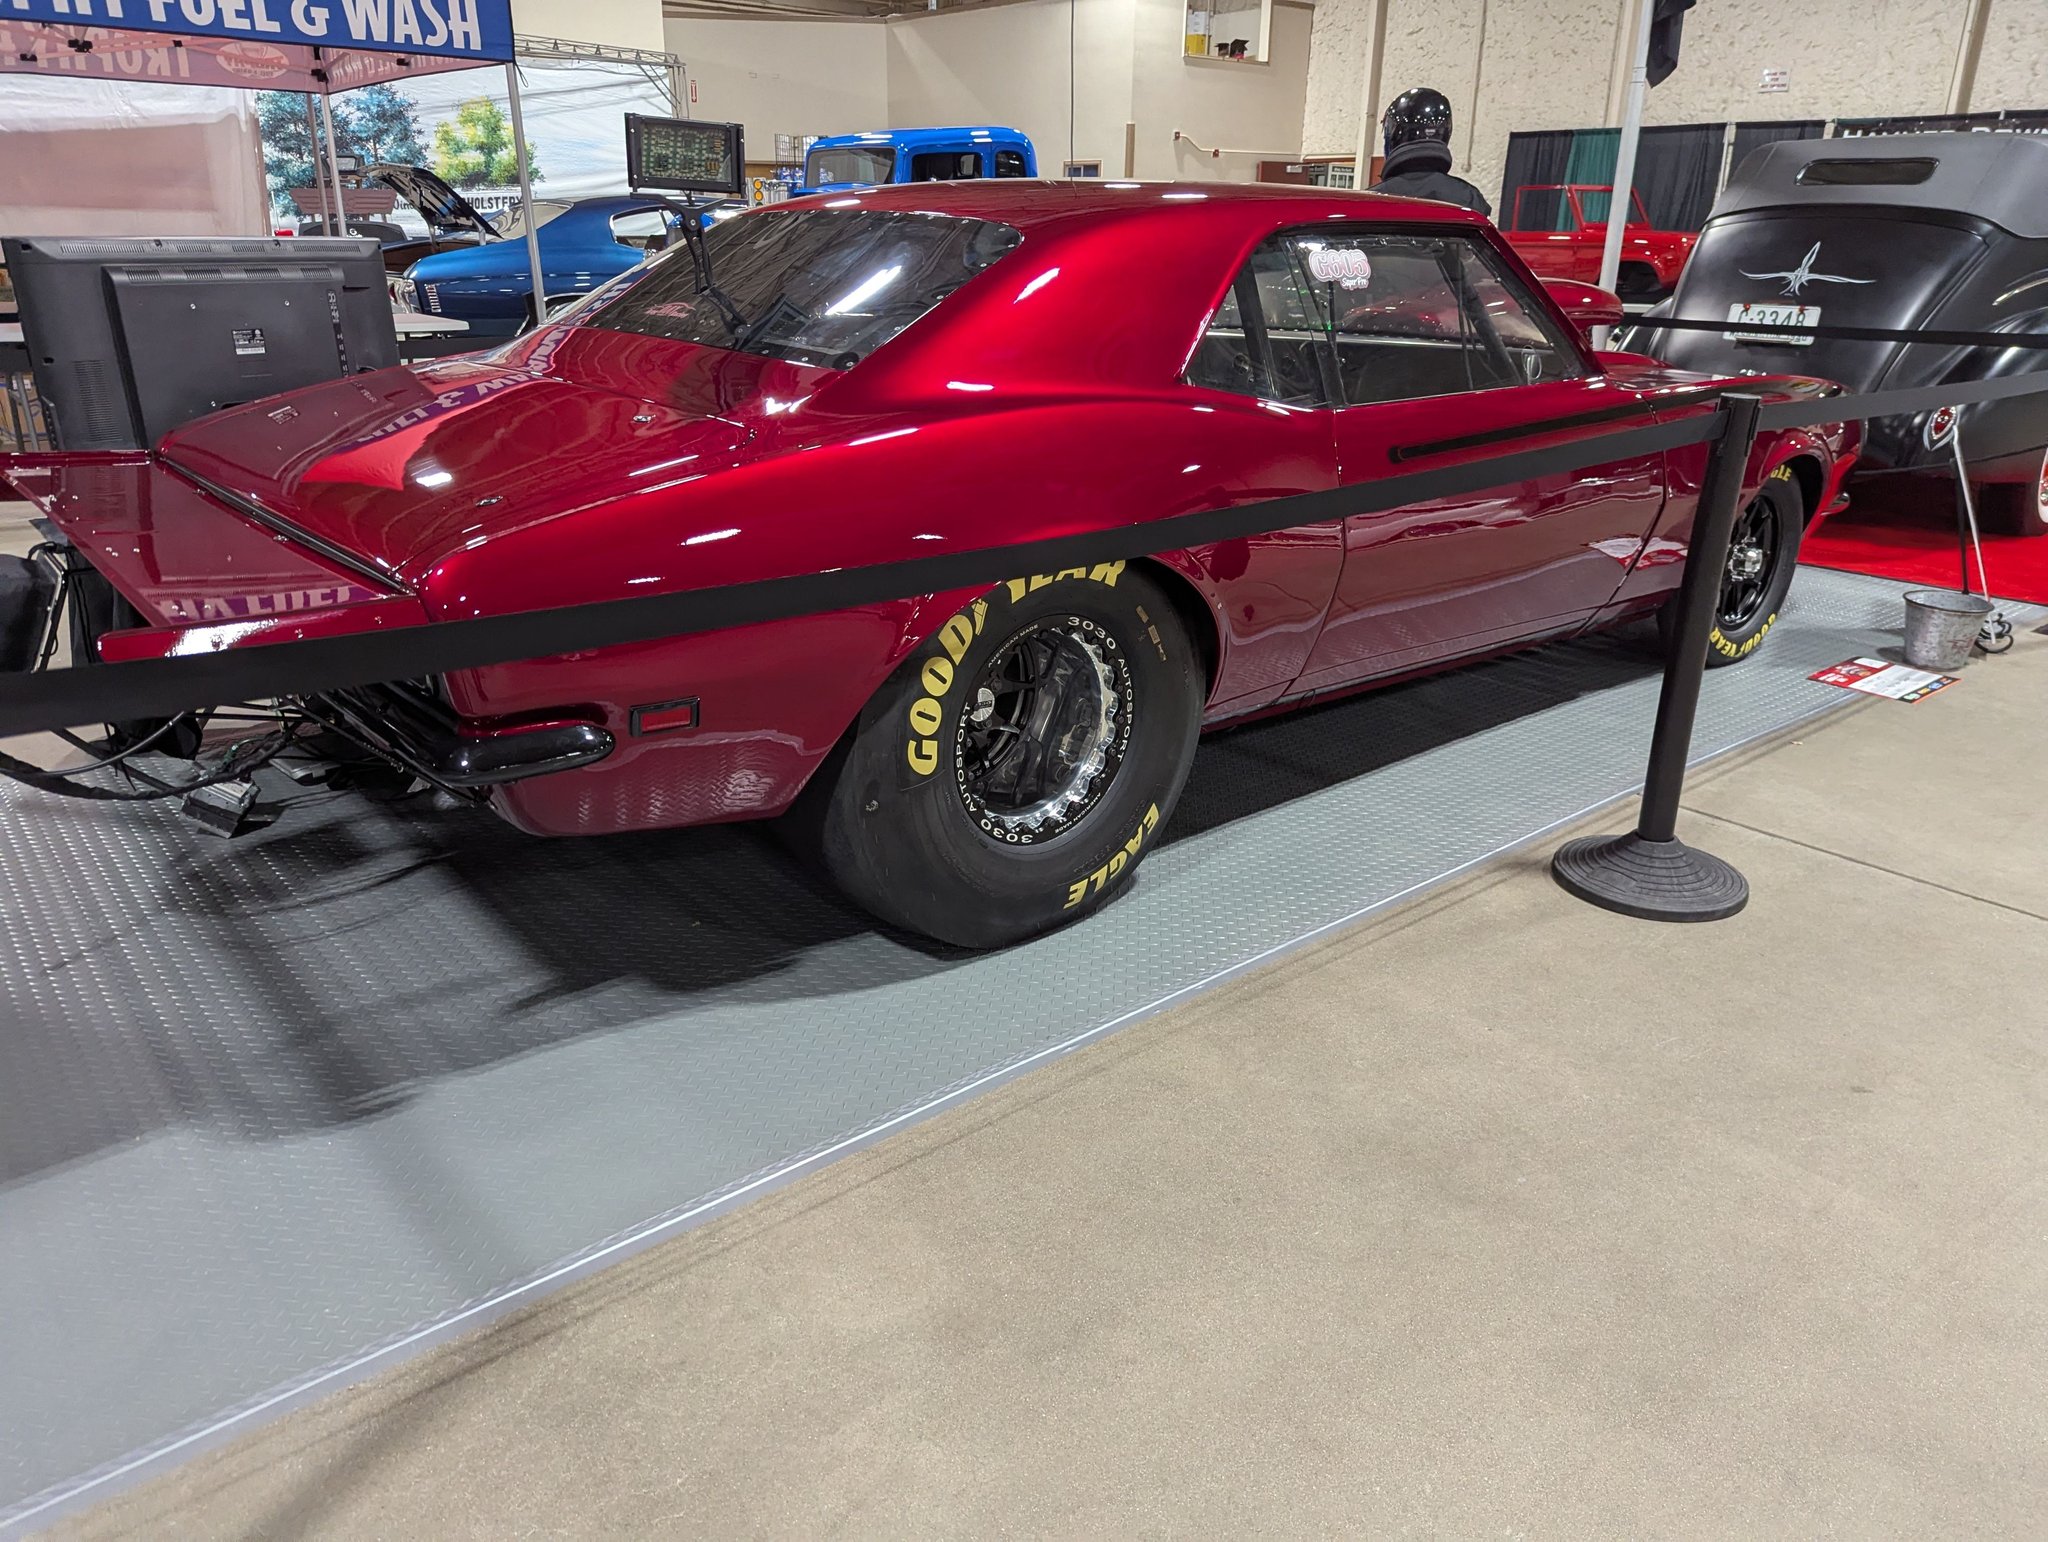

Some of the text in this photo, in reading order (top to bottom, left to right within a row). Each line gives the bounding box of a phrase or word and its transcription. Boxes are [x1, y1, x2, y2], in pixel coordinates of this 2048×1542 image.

[342, 0, 482, 51] WASH
[987, 623, 1039, 669] AMERICAN MADE
[1067, 616, 1117, 650] 3030
[1118, 658, 1134, 763] AUTOSPORT
[955, 702, 978, 813] AUTOSPORT
[980, 818, 1034, 844] 3030
[1054, 792, 1102, 834] AMERICAN MADE
[1062, 802, 1161, 911] EAGLE
